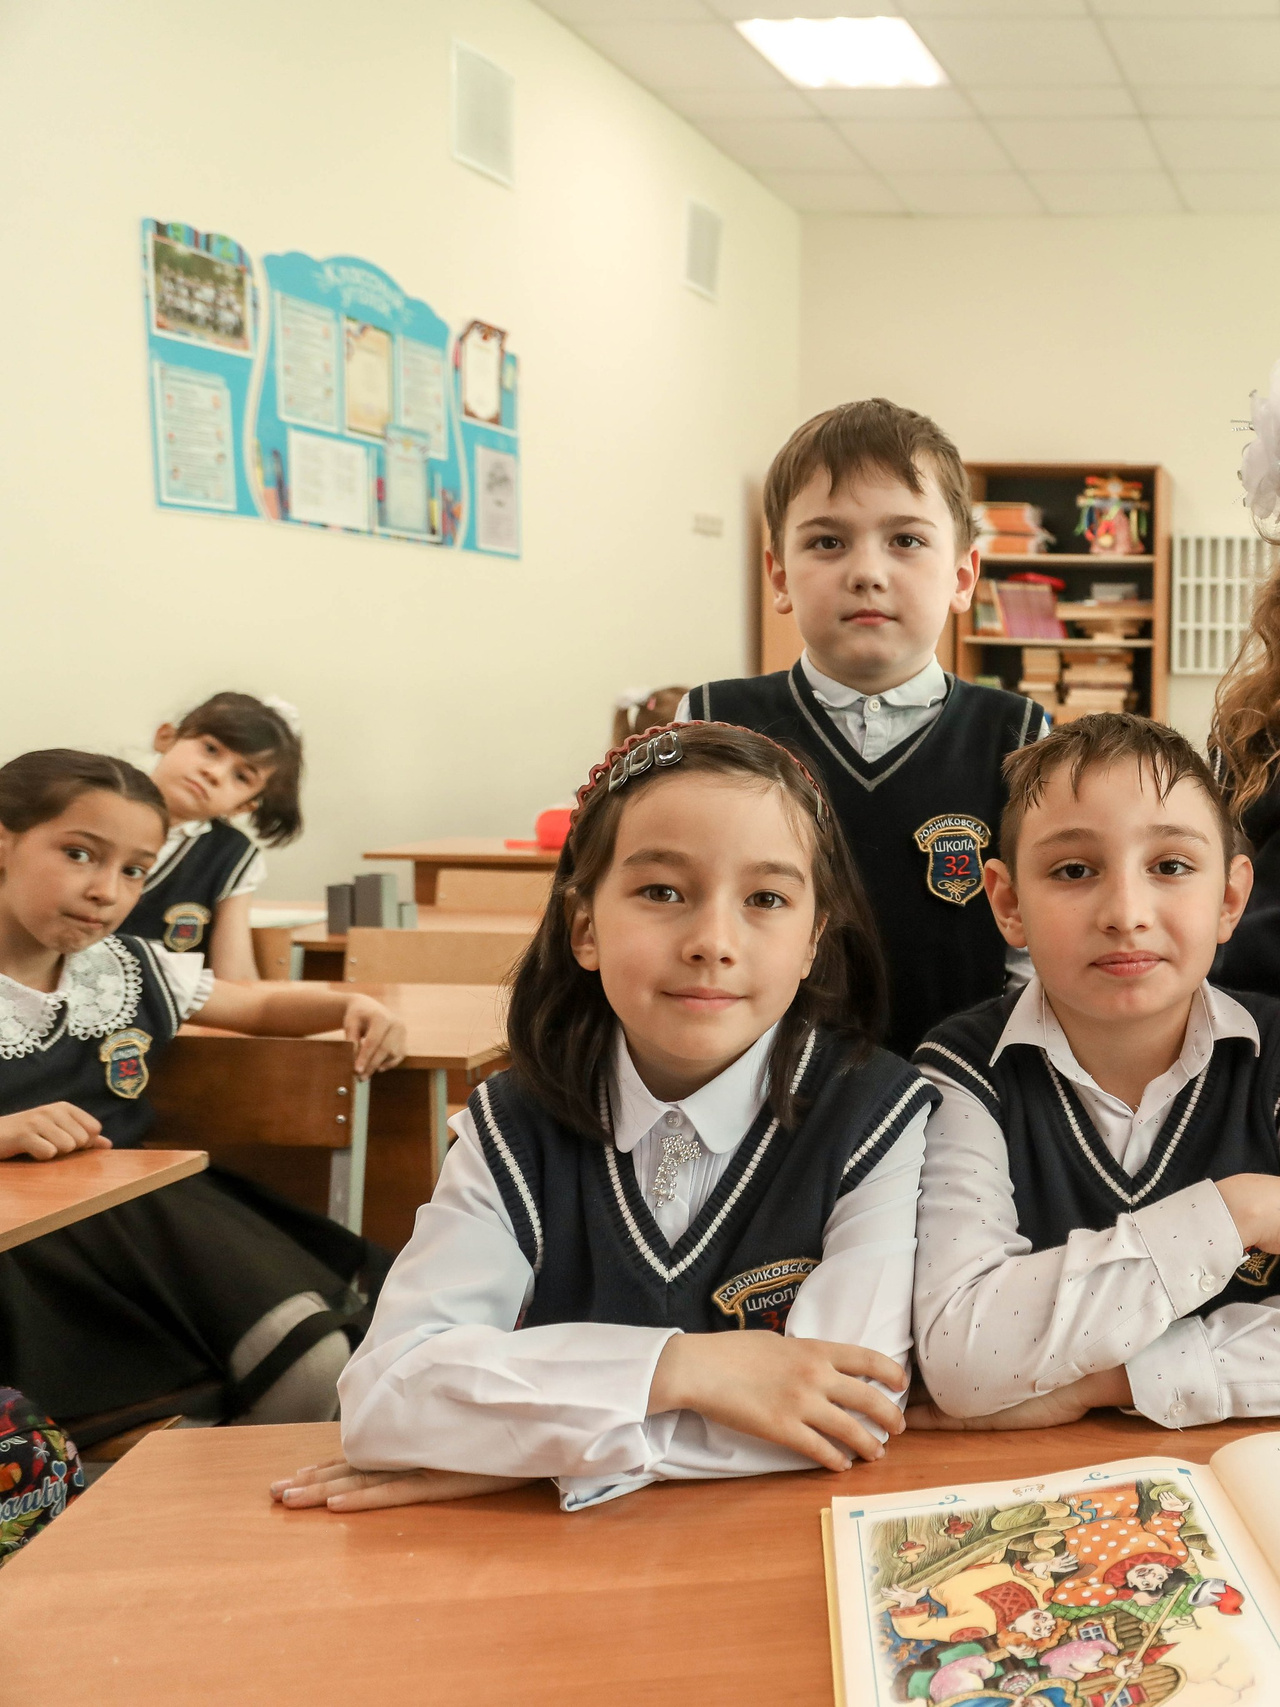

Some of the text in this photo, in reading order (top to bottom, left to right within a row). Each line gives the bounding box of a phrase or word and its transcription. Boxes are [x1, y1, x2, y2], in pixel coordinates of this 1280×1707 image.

[934, 838, 975, 852] ШКОЛА
[944, 854, 971, 876] 32
[720, 1262, 815, 1302] РОДНИКОВСКА
[0, 1476, 68, 1519] auty
